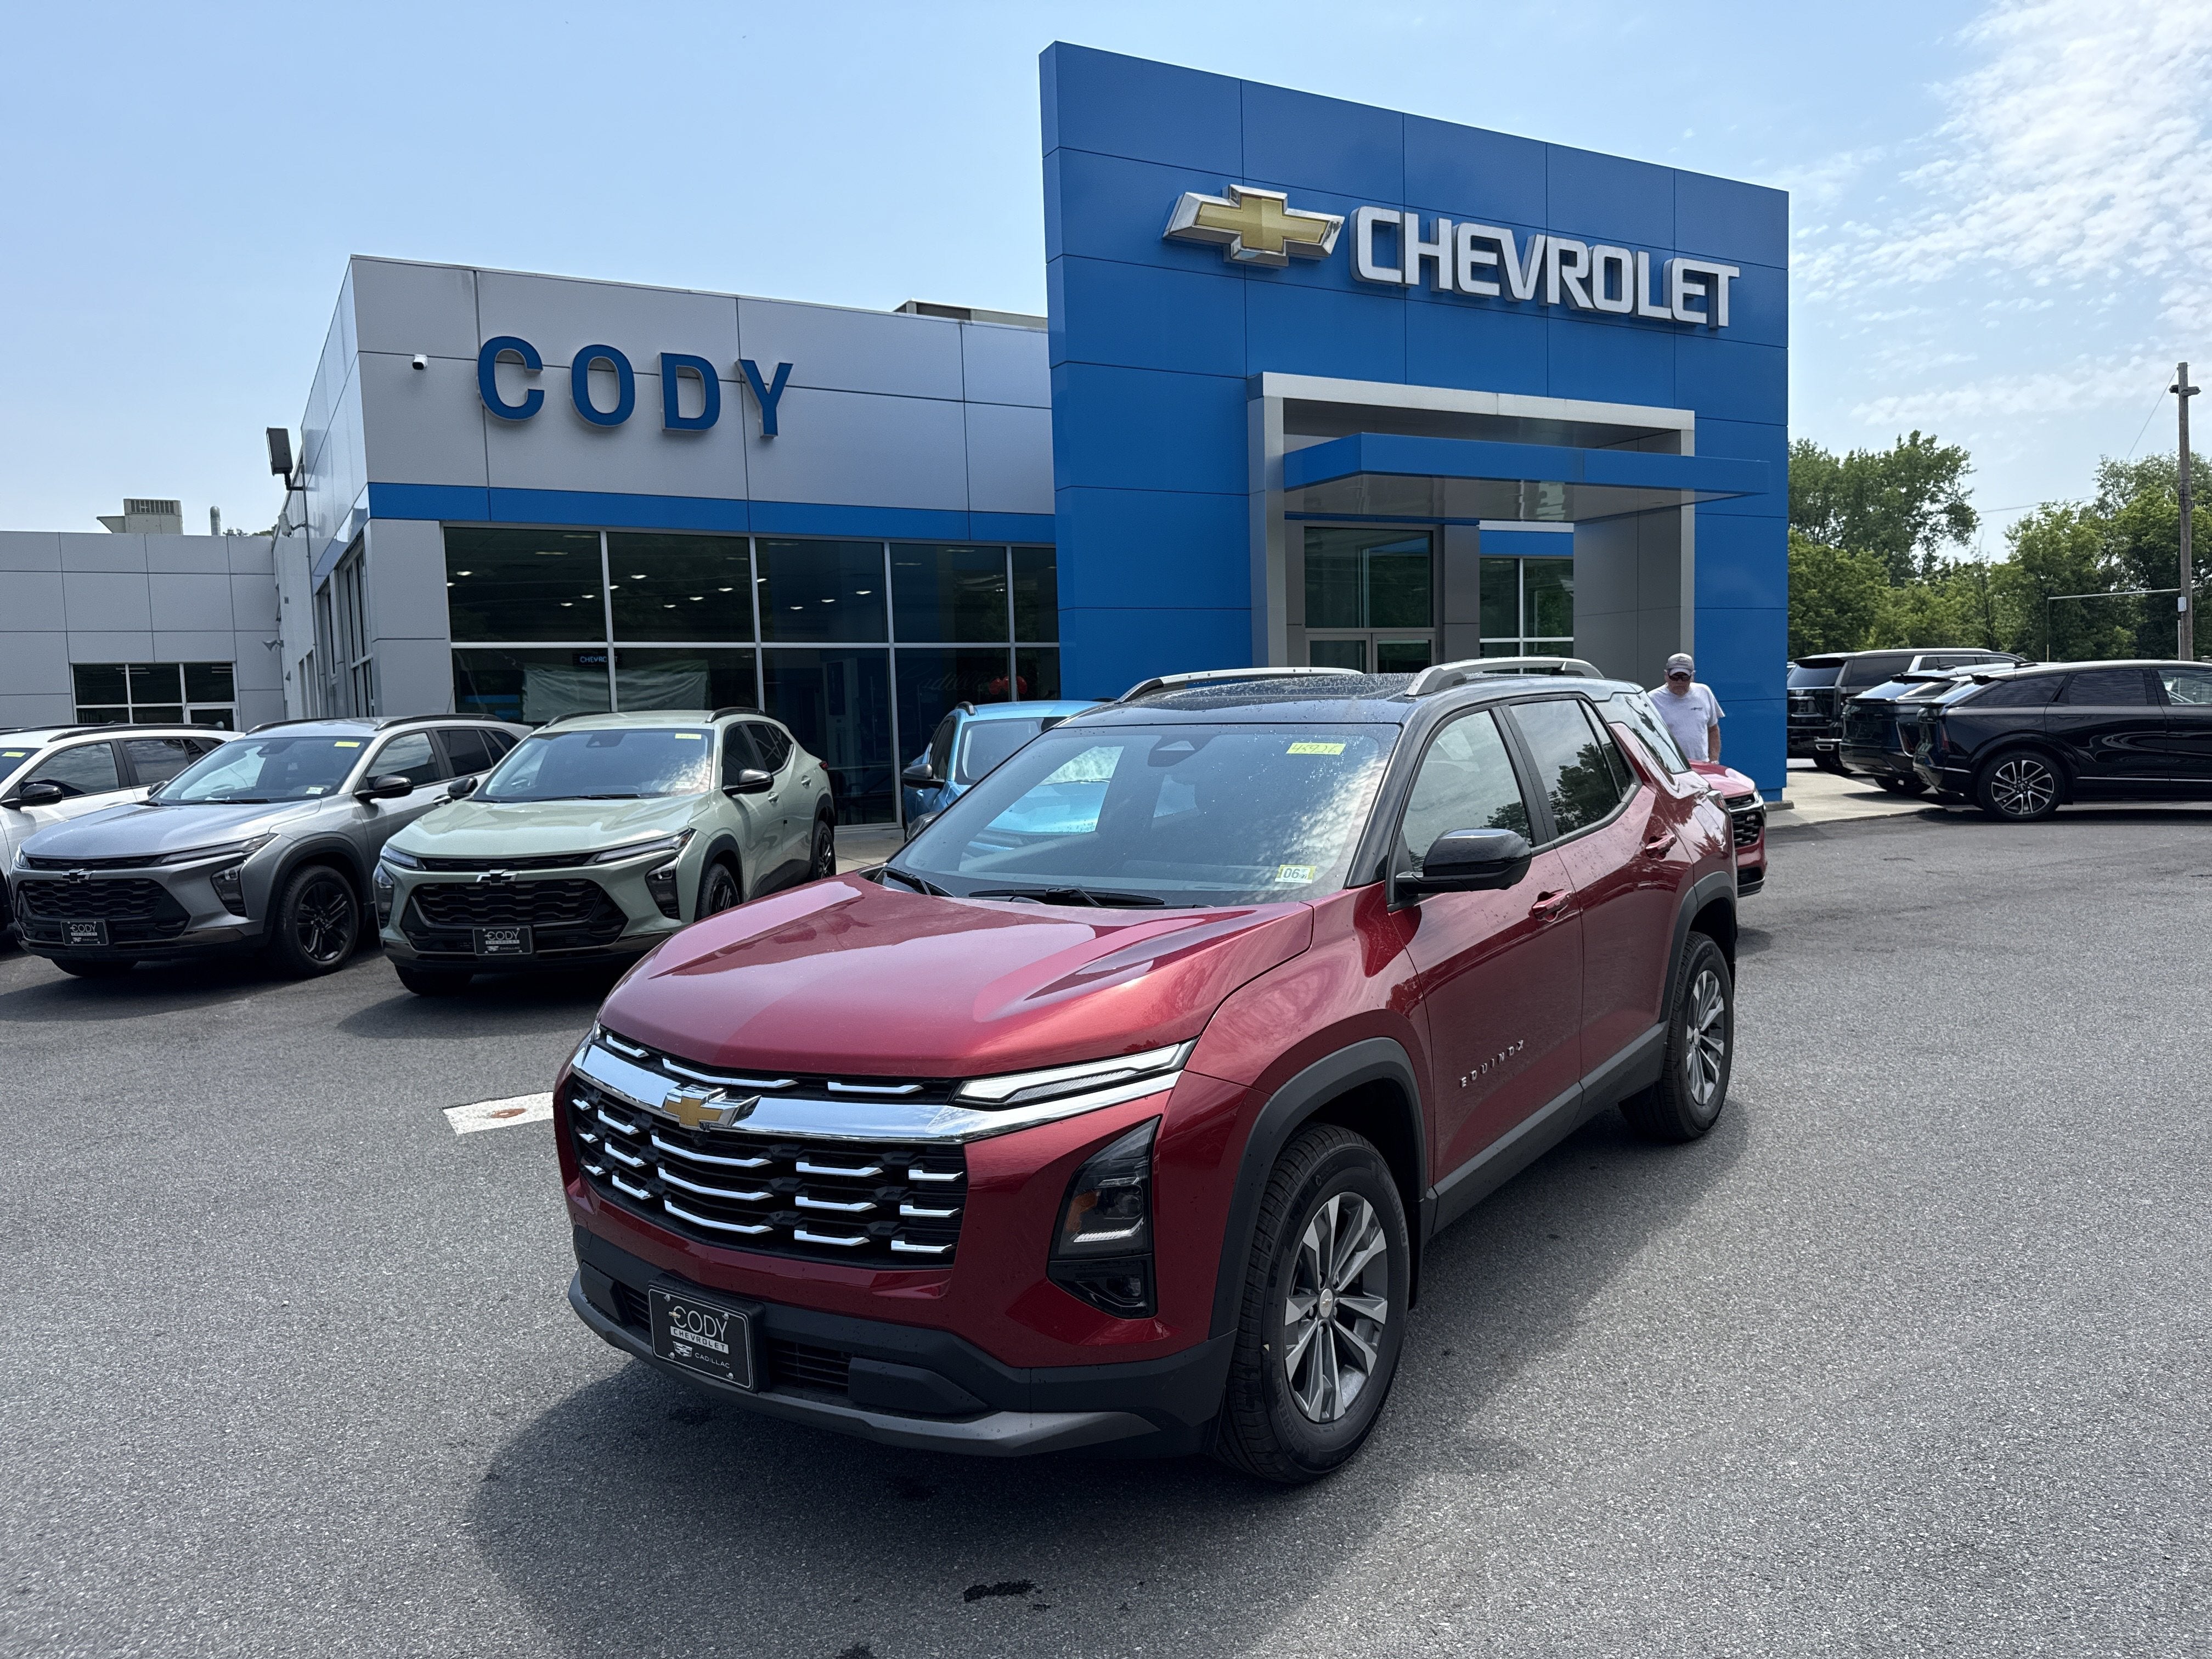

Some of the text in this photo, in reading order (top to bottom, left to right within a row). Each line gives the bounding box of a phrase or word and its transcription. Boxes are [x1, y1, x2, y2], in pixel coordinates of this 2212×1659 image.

[1350, 205, 1740, 329] CHEVROLET
[476, 336, 794, 439] CODY
[1284, 868, 1300, 878] 06
[71, 924, 96, 933] CODY
[487, 931, 519, 940] CODY
[1460, 1040, 1523, 1087] EQUINOX
[673, 1306, 727, 1341] CODY
[673, 1328, 727, 1352] CHEVROLET
[695, 1352, 731, 1369] CADILLAC
